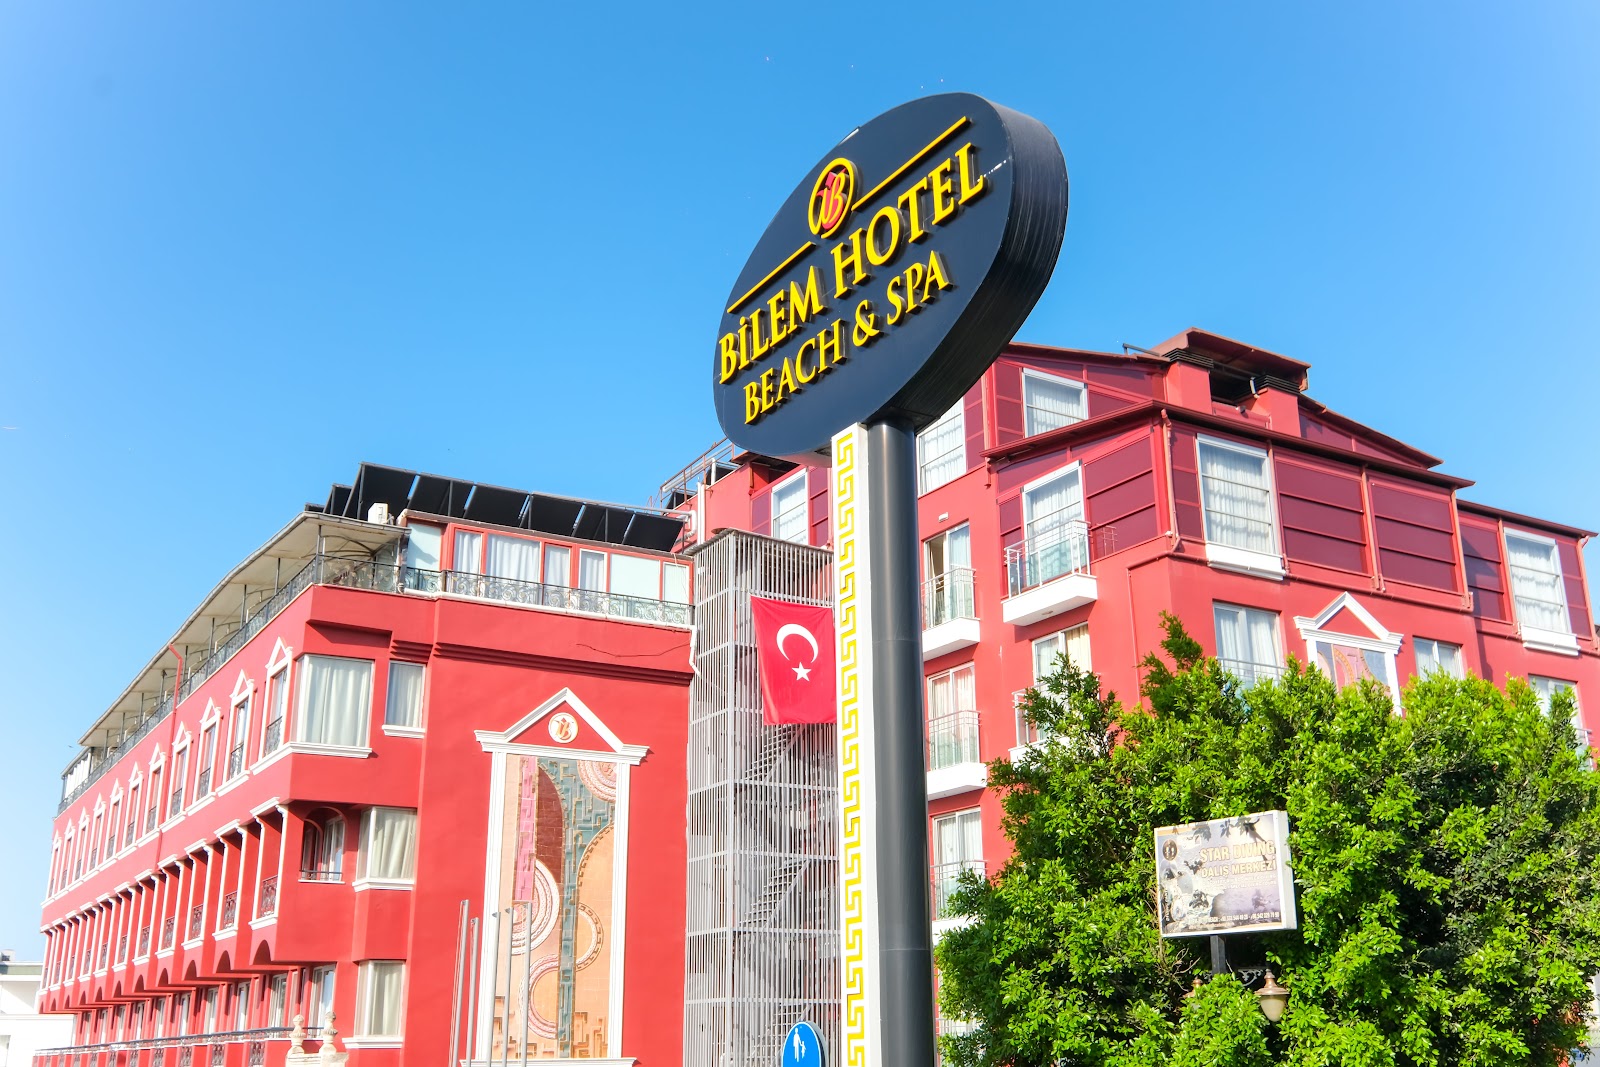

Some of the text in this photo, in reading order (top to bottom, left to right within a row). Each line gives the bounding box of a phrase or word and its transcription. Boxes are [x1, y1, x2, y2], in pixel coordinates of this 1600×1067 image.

[831, 142, 984, 299] HOTEL
[744, 250, 949, 425] BEACH & SPA
[1200, 840, 1275, 863] STAR DIVING
[1201, 856, 1277, 878] DALIŞ MERKEZİ
